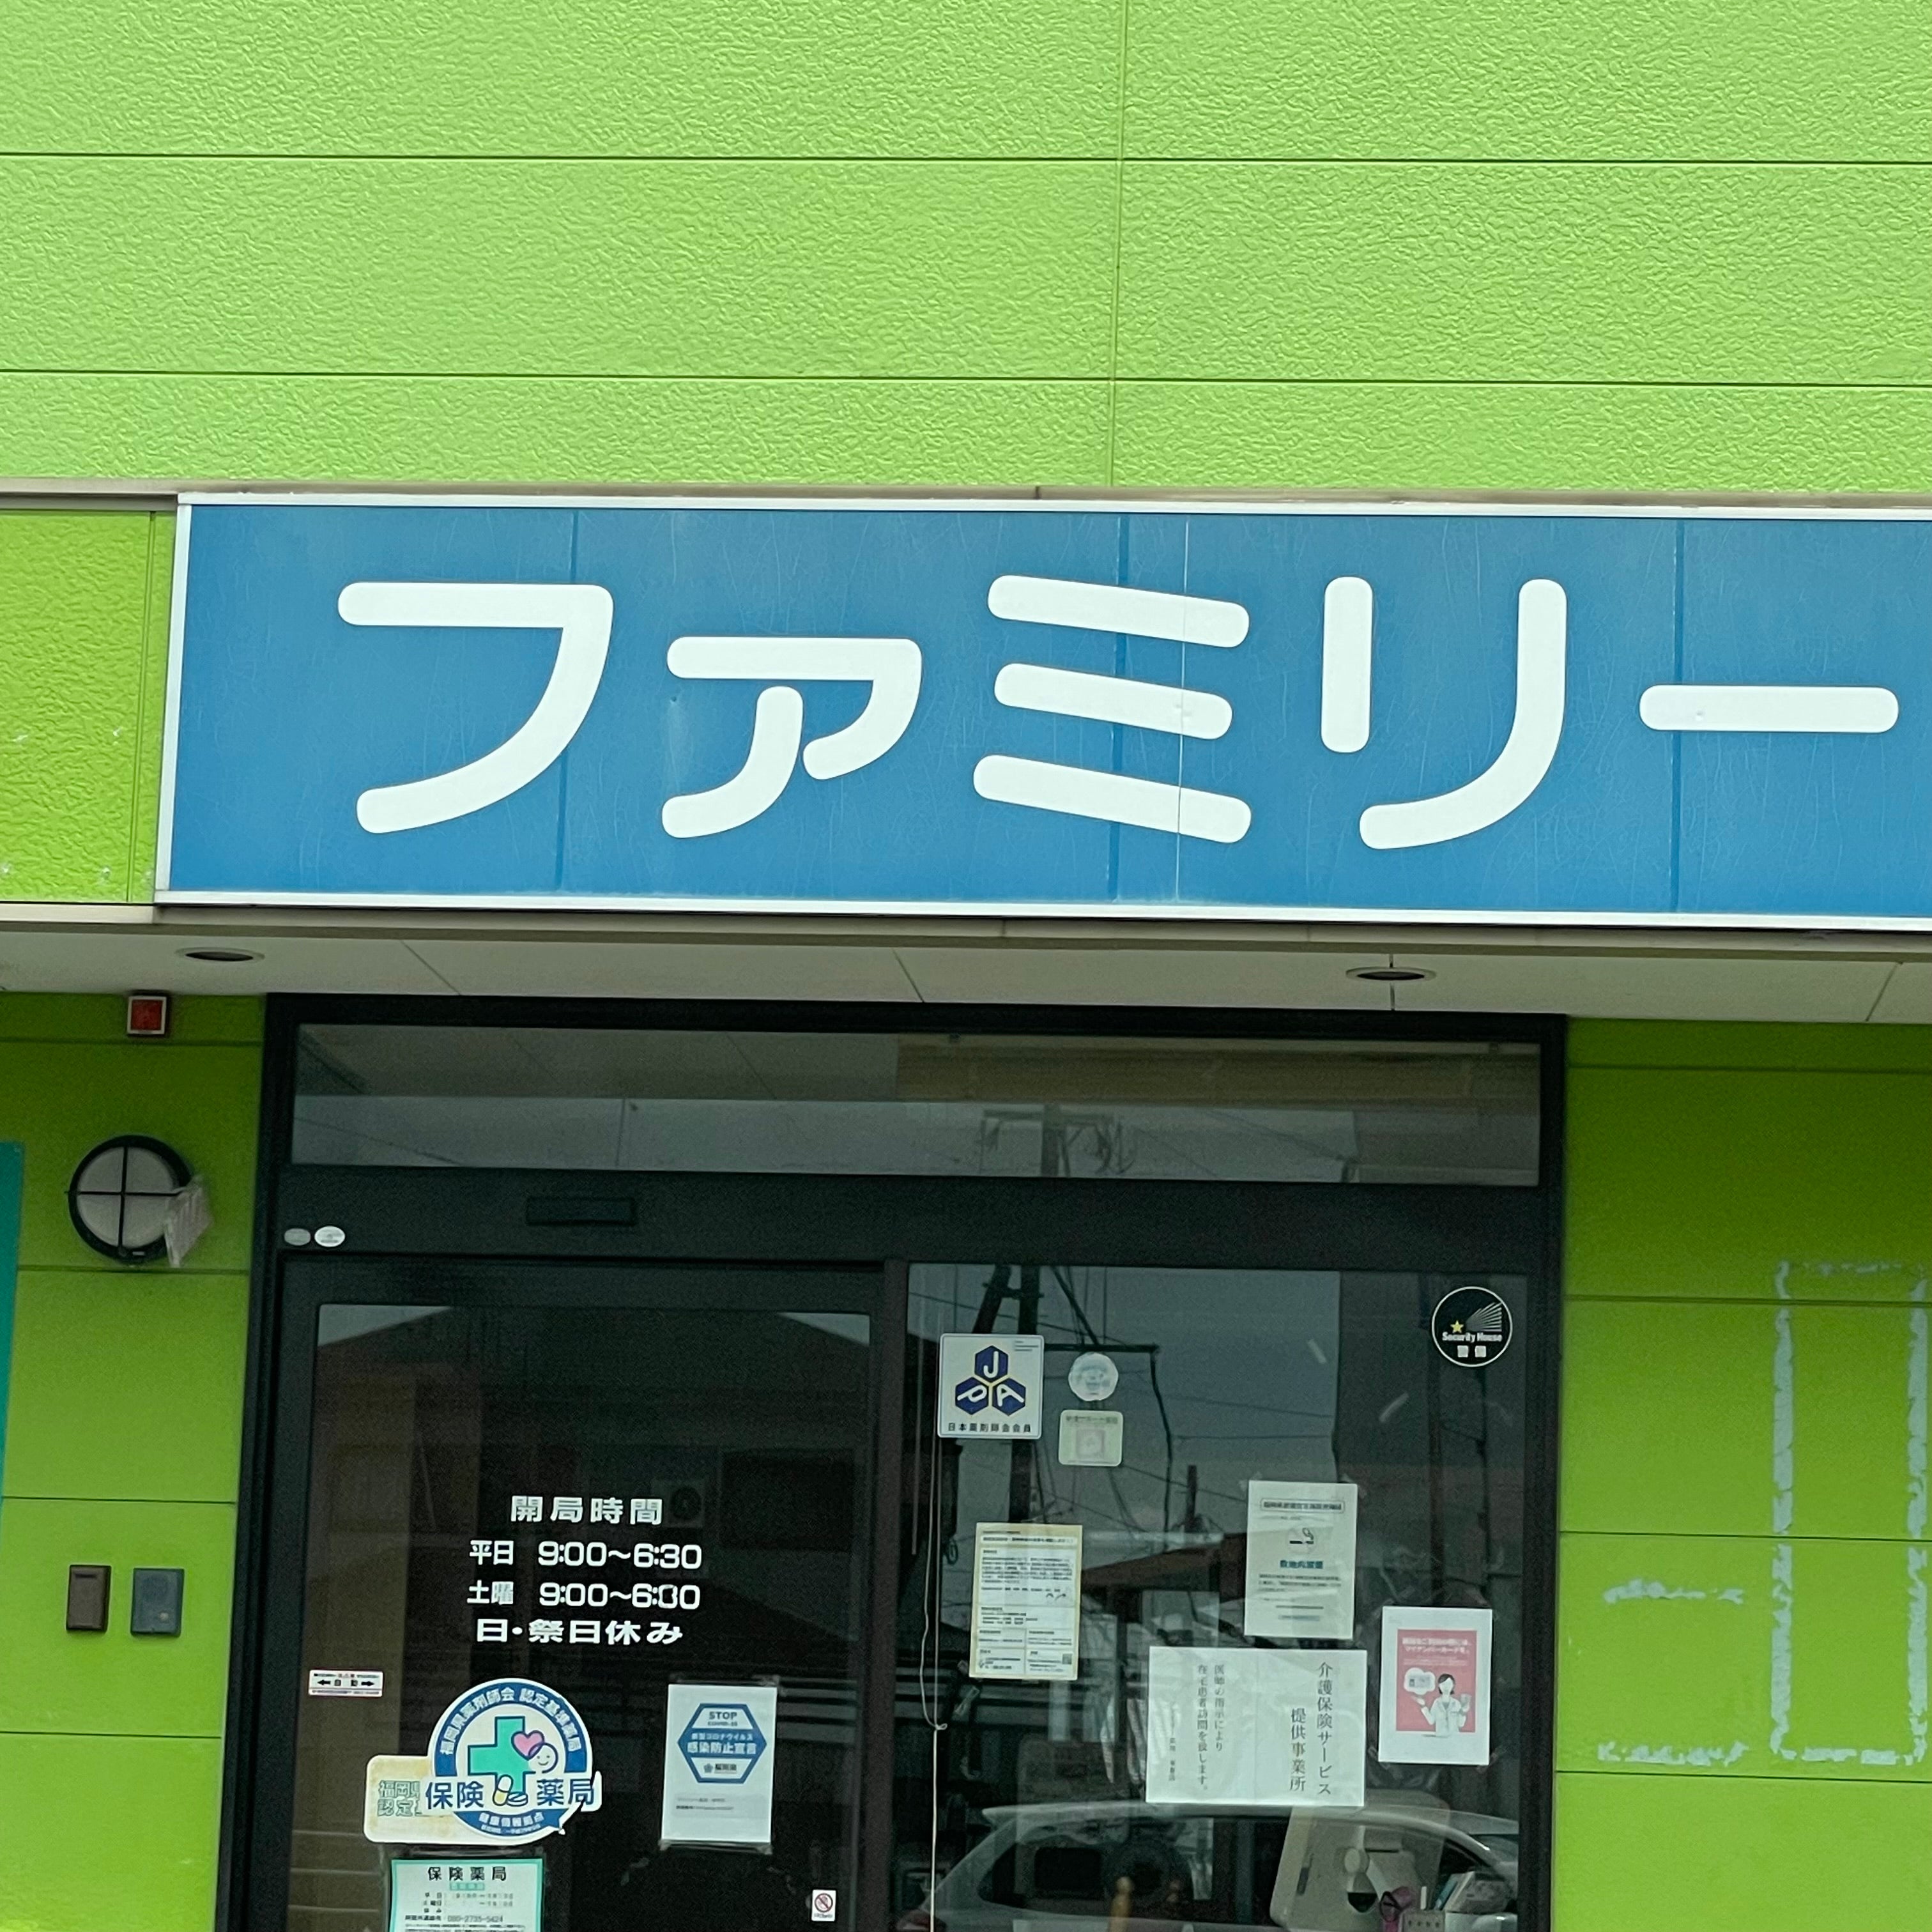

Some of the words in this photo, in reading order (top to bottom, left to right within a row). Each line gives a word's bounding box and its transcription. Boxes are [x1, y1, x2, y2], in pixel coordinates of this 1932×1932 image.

[337, 574, 1899, 851] ファミリー
[511, 1496, 663, 1525] 開局時間
[470, 1540, 514, 1565] 平日
[467, 1580, 514, 1605] 土曜
[709, 1711, 737, 1720] STOP
[1317, 1662, 1333, 1795] 介護保険サービス
[687, 1742, 757, 1754] 感染防止宣言
[1289, 1708, 1306, 1791] 提供事業所
[425, 1781, 484, 1809] 保険
[536, 1779, 595, 1807] 薬局
[377, 1799, 423, 1817] 認定
[427, 1866, 507, 1881] 保険薬局
